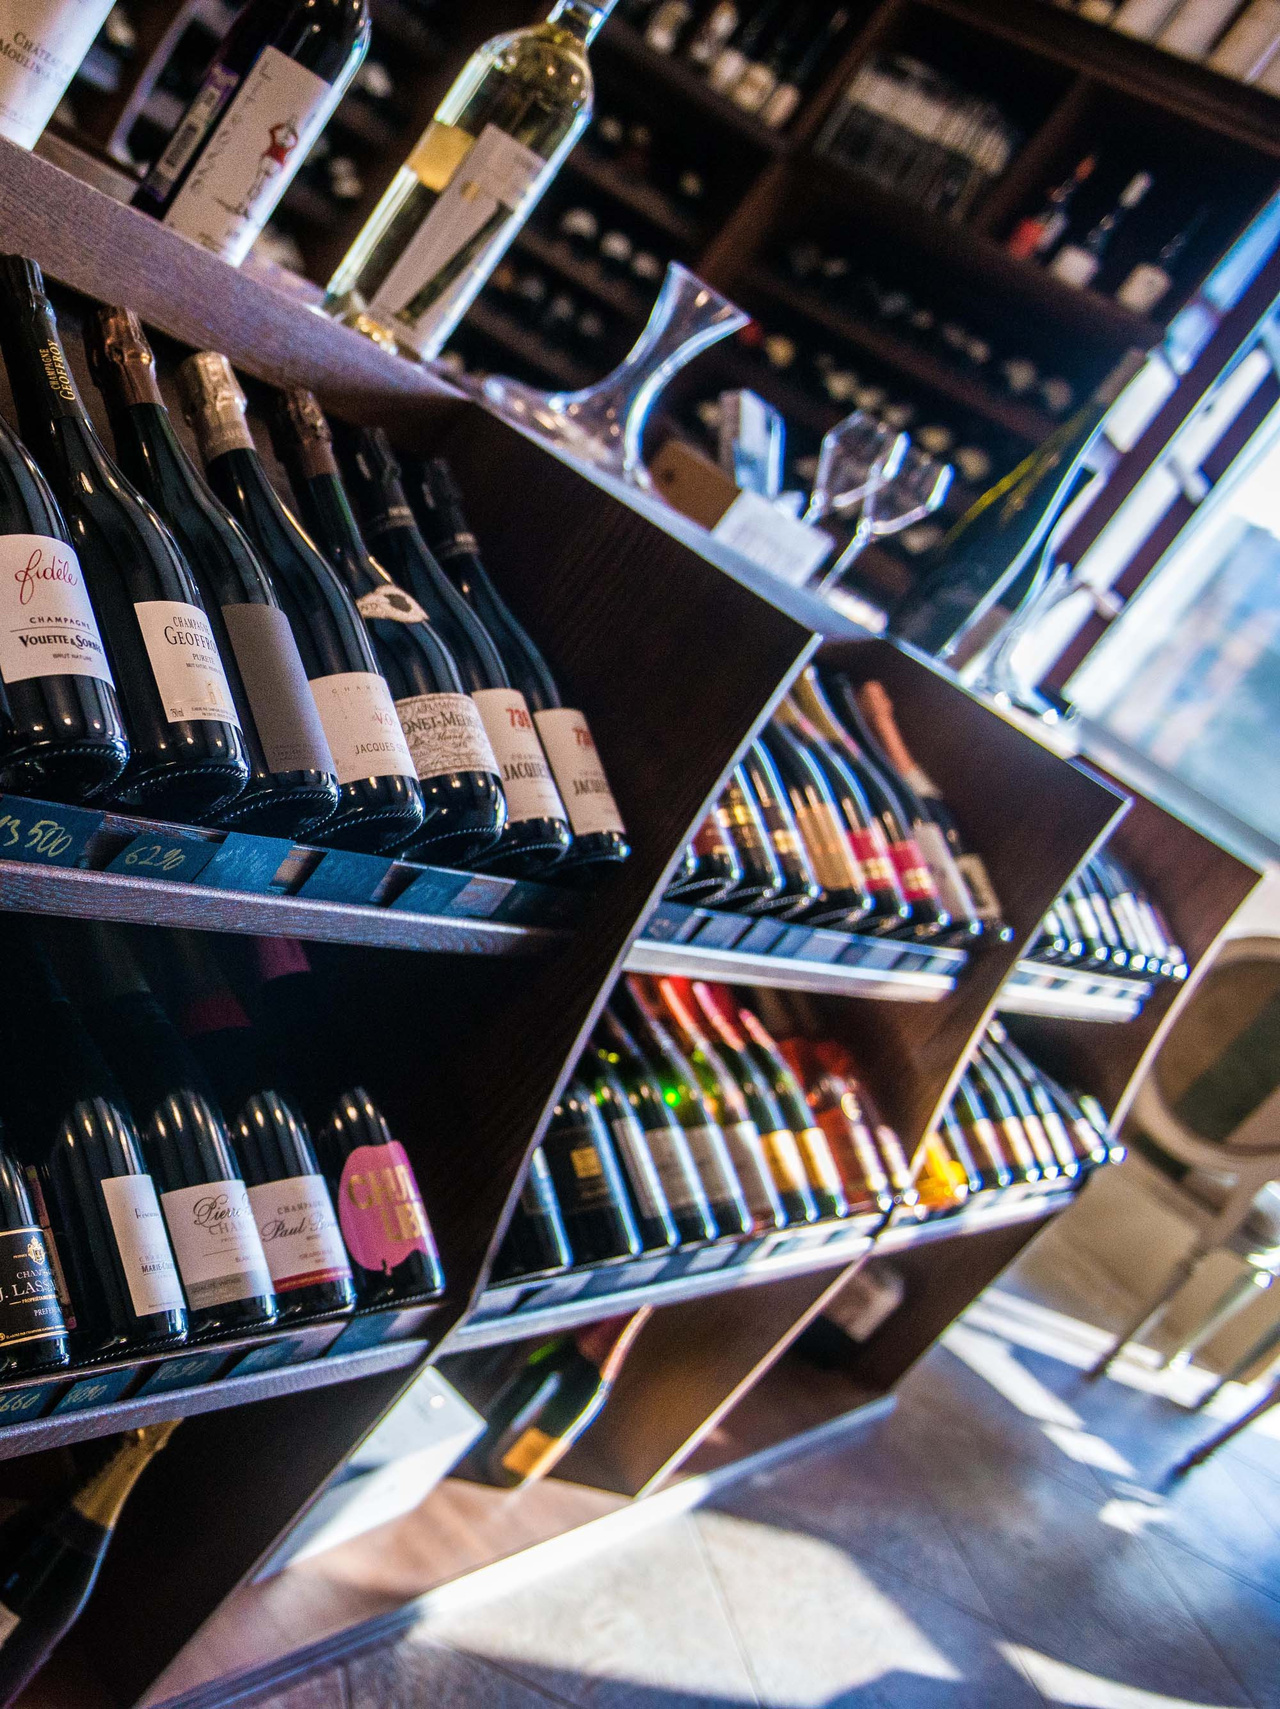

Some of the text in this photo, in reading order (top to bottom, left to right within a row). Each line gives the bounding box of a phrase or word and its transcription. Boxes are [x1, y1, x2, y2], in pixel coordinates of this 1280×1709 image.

[38, 348, 61, 391] CHAMPAGNE
[47, 339, 77, 401] GEOFFROY
[14, 548, 79, 605] fidèle
[29, 615, 91, 631] CHAMPAGNE
[18, 634, 69, 648] VOUETTE
[354, 742, 396, 756] JACQUES
[262, 1217, 307, 1243] Paul
